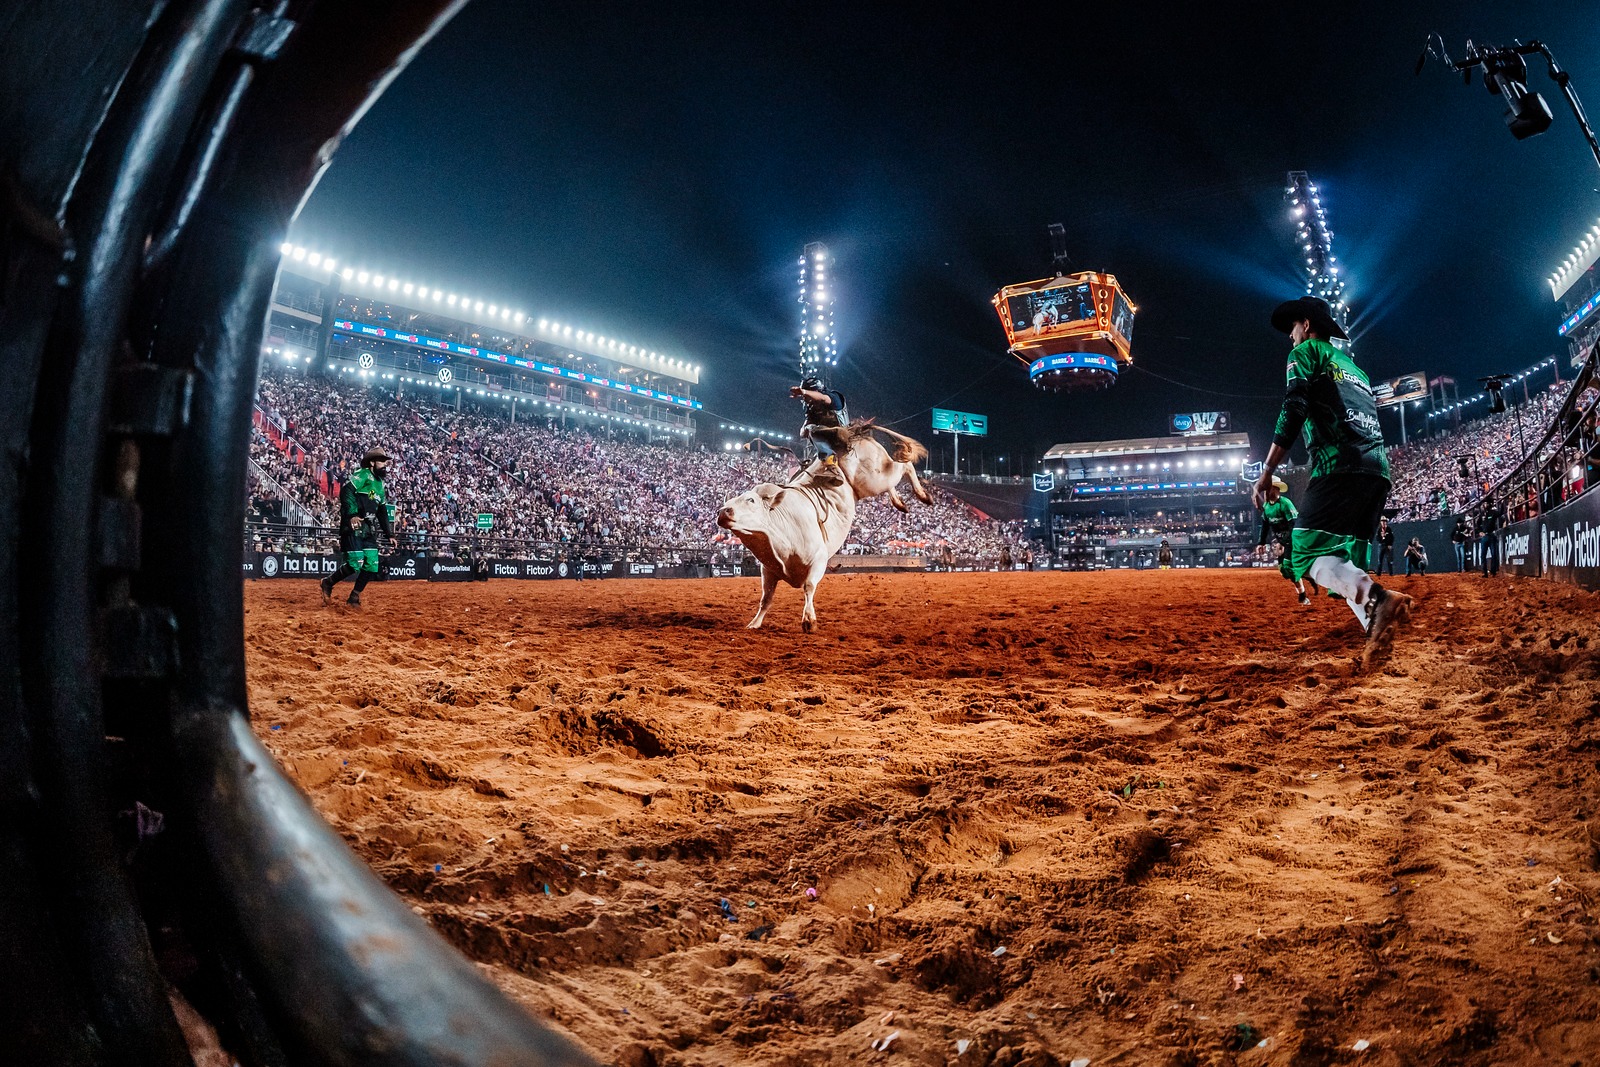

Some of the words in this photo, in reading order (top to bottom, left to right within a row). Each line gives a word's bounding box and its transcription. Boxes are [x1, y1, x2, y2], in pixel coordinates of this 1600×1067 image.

[1550, 530, 1568, 567] Fictor
[283, 555, 300, 571] ha
[303, 556, 319, 571] ha
[322, 557, 338, 572] ha
[526, 564, 549, 575] Fictor
[583, 562, 614, 572] Ecower
